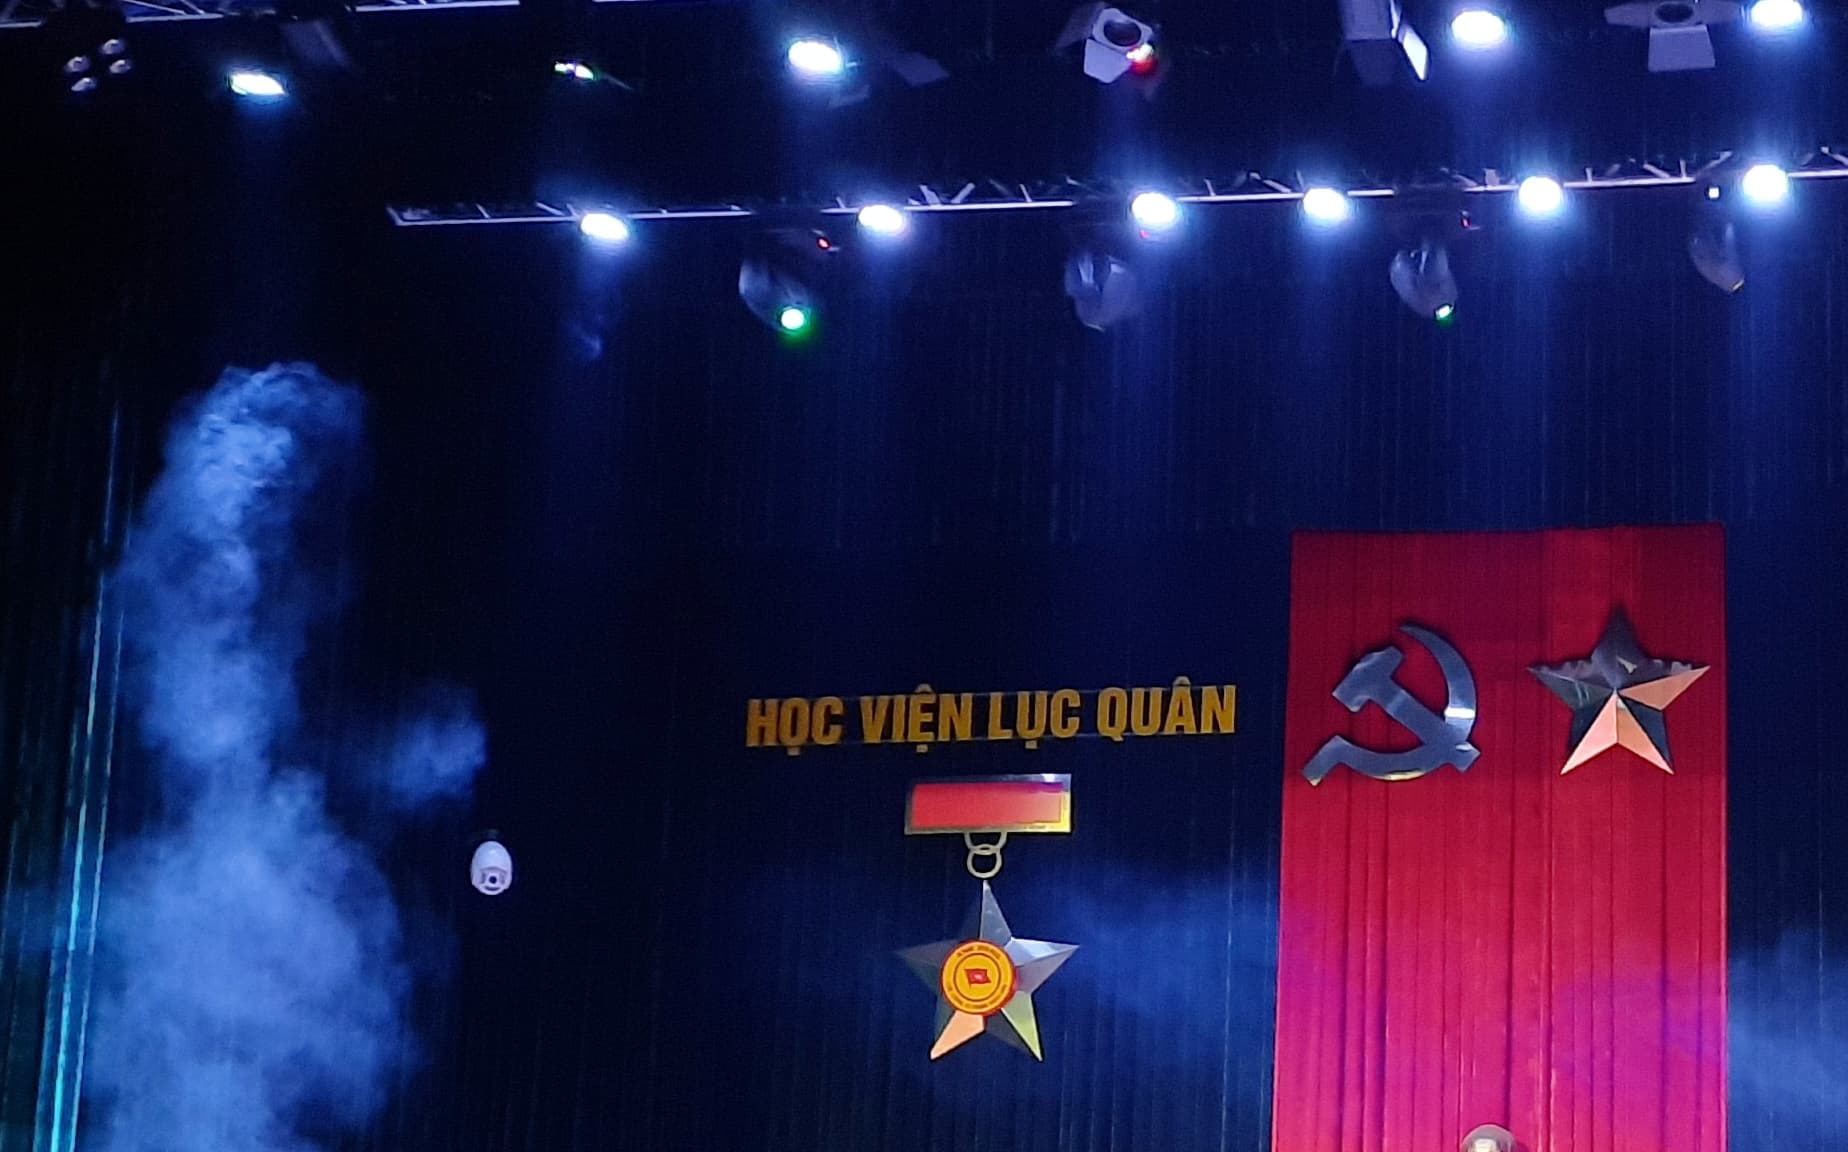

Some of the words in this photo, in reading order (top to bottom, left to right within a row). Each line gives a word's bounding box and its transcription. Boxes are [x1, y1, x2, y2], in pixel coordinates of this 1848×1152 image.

[746, 696, 845, 756] HỌC
[859, 683, 974, 753] VIỆN
[988, 688, 1080, 750] LỤC
[1096, 676, 1237, 741] QUÂN
